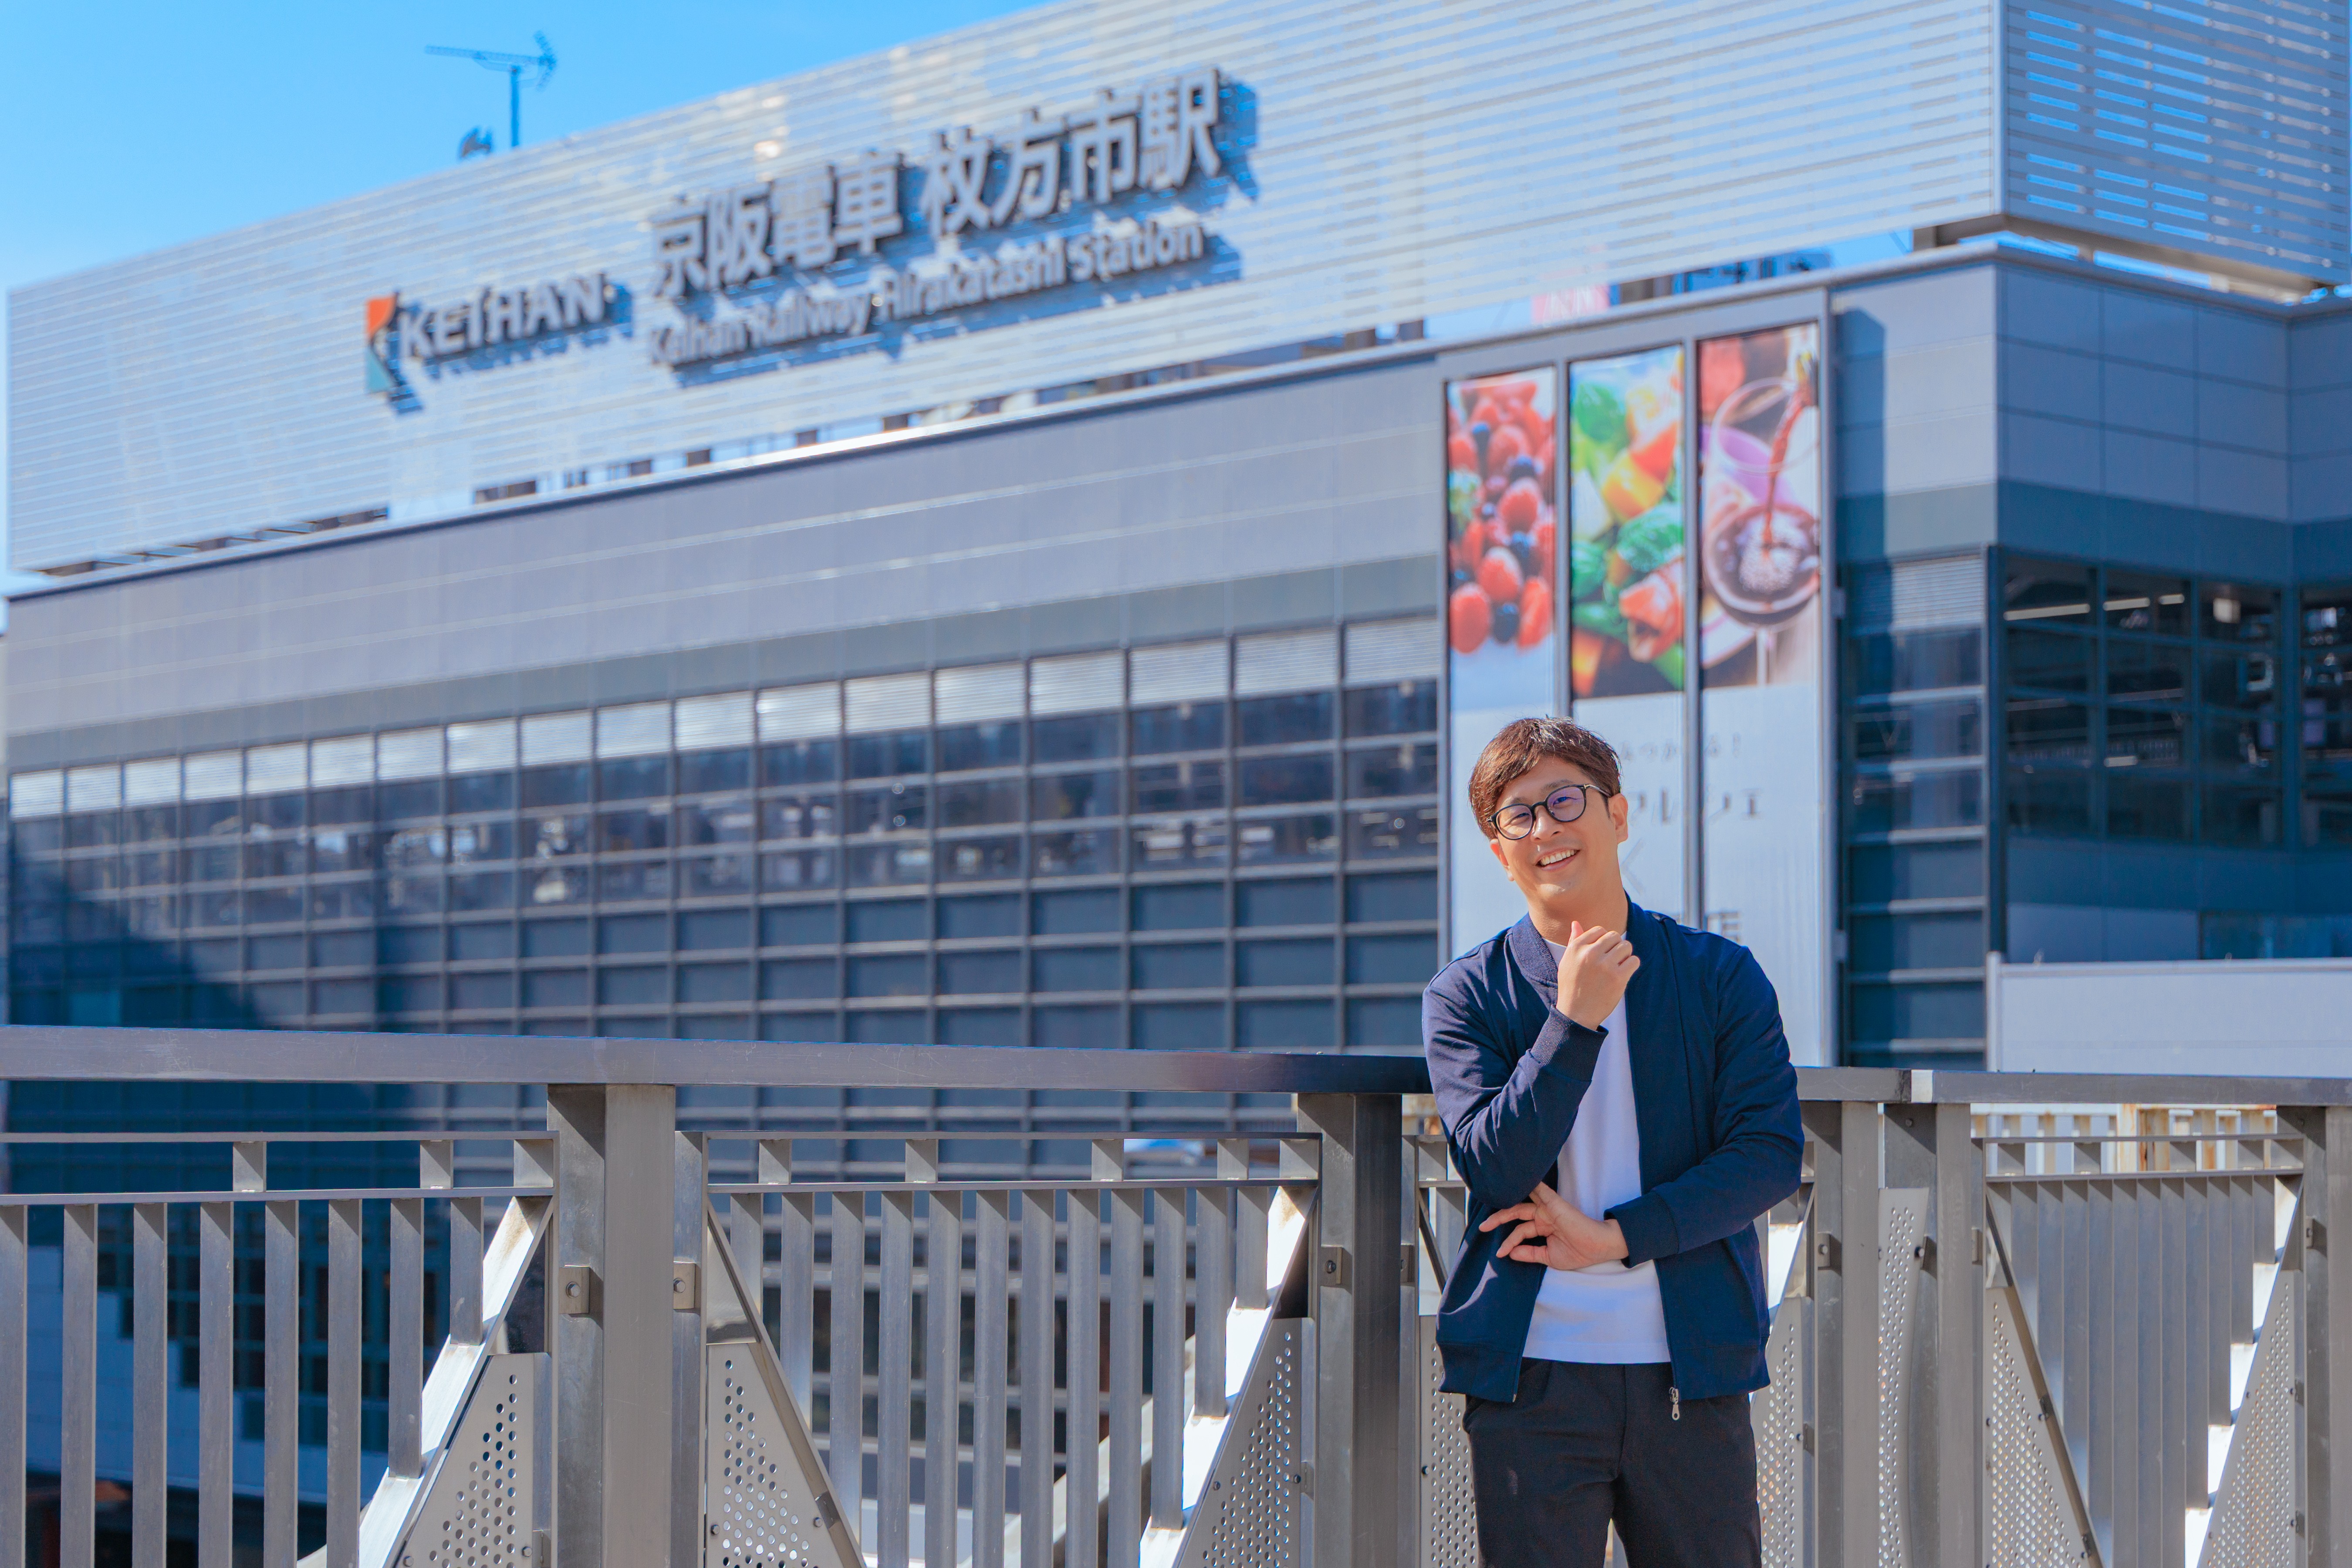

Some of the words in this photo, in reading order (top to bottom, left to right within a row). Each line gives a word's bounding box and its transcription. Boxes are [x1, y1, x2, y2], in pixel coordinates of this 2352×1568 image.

[652, 150, 903, 298] 京阪電車
[918, 69, 1221, 240] 枚方市駅
[397, 274, 607, 361] KEIHAN
[652, 310, 748, 365] Keihan
[750, 288, 872, 350] Railway
[875, 237, 1067, 323] Hirakatashi
[1072, 219, 1204, 282] Station
